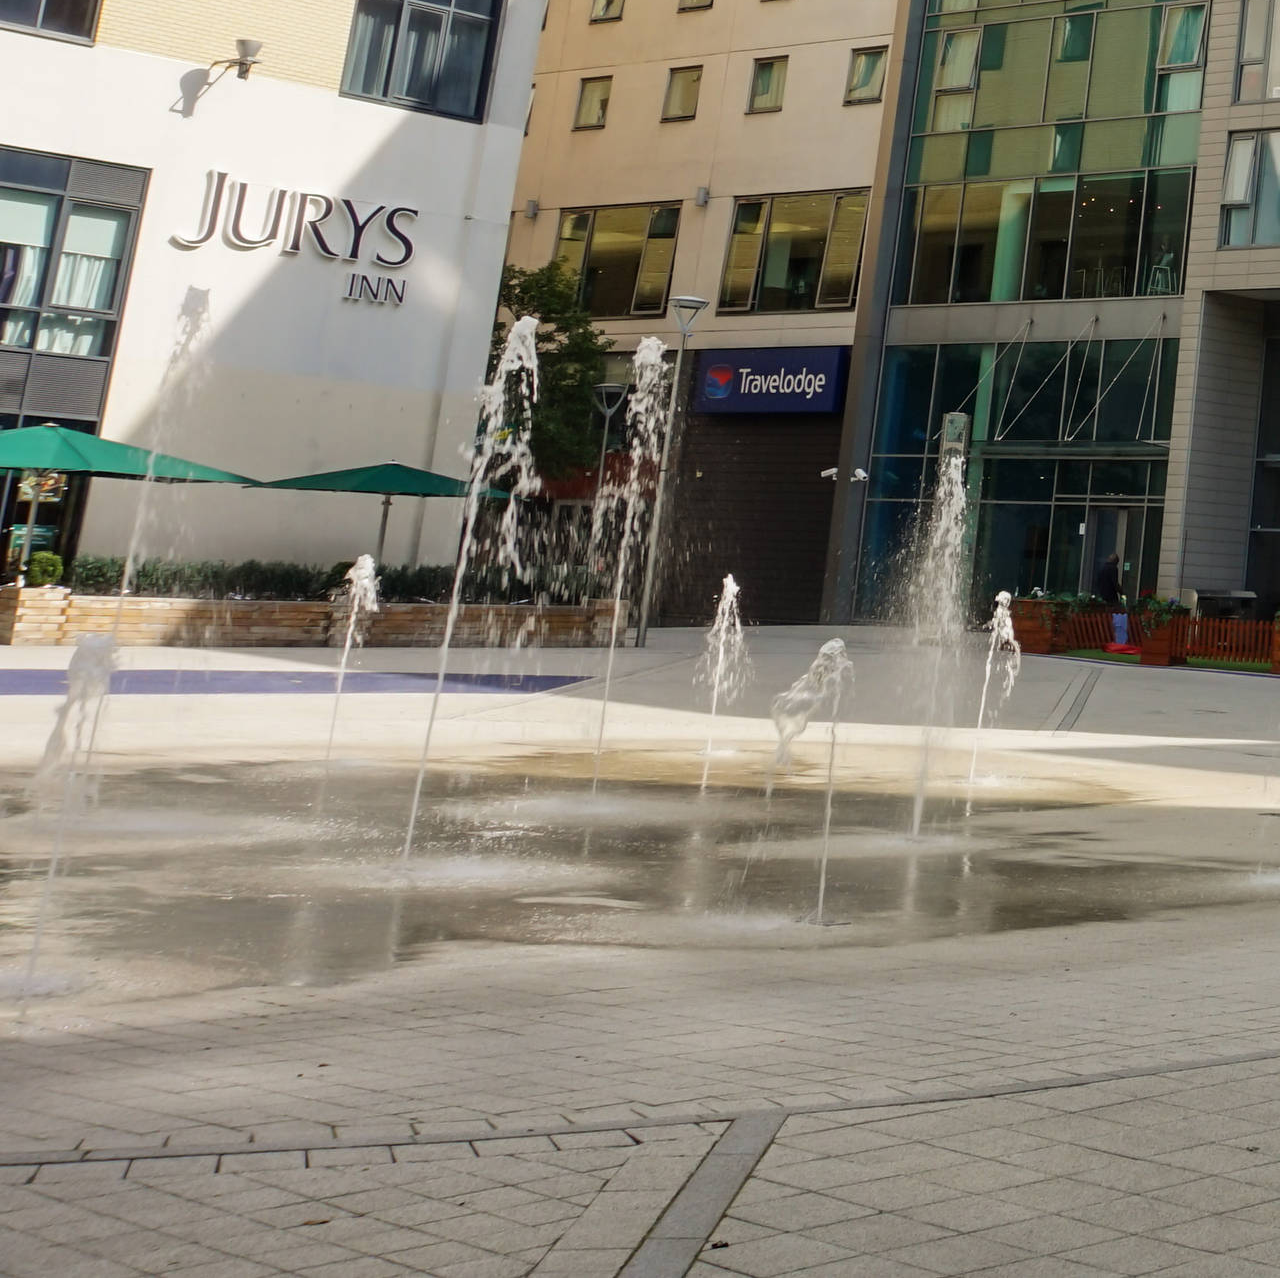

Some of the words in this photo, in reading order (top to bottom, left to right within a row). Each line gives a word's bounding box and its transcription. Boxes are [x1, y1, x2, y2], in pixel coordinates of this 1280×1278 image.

[171, 170, 419, 267] JURYS
[346, 273, 407, 304] INN
[738, 367, 826, 399] Travelodge
